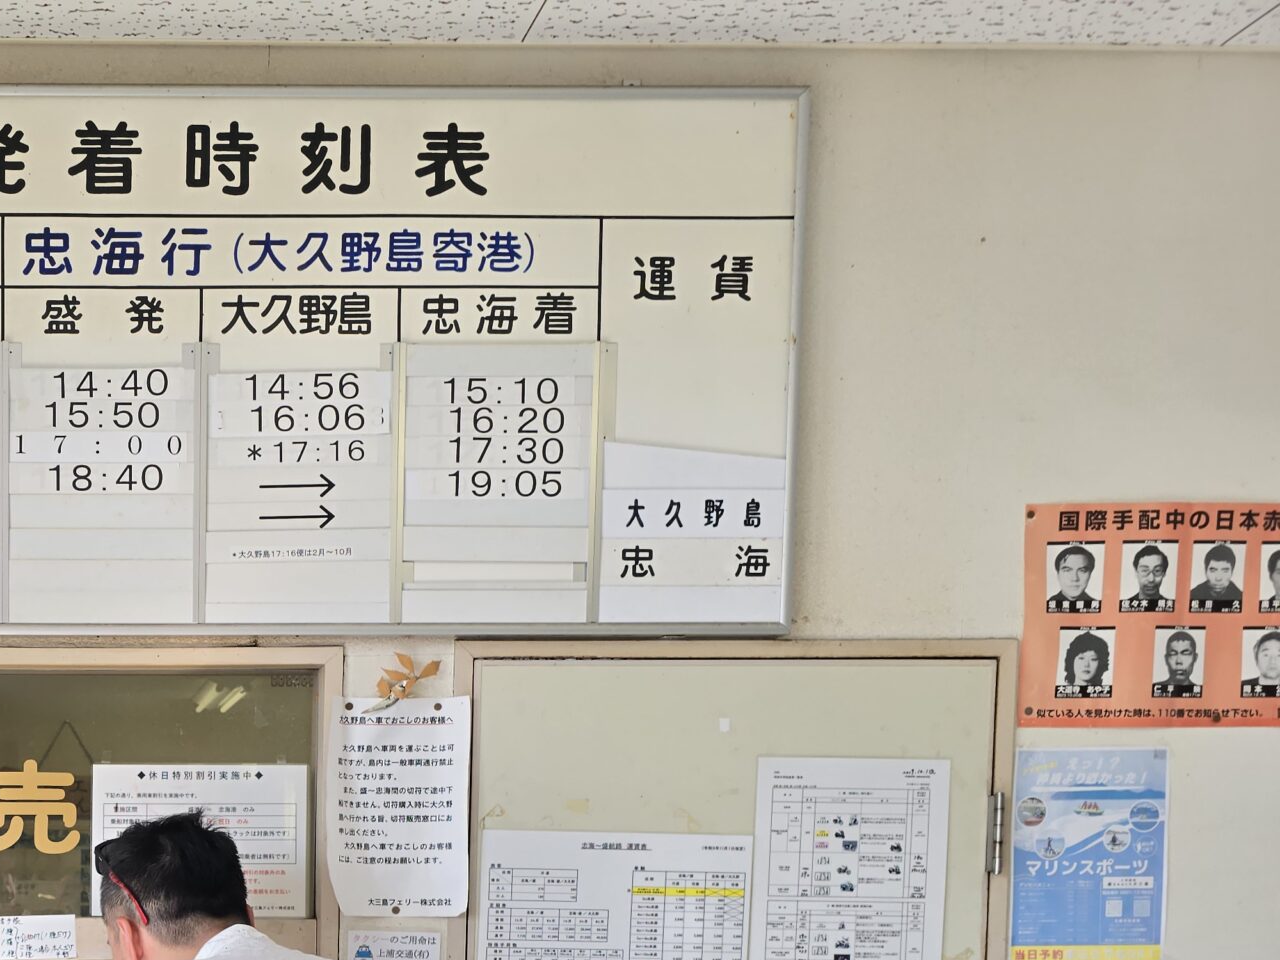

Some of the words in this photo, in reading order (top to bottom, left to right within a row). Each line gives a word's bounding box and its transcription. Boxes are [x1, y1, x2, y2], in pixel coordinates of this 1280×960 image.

[634, 255, 753, 301] 運賃
[42, 295, 164, 334] 盛発
[222, 292, 371, 334] 大久野島
[423, 292, 576, 334] 忠海着
[54, 369, 168, 398] 14:40
[246, 373, 358, 400] 14:56
[444, 378, 558, 404] 15:10
[46, 402, 159, 428] 15:50
[251, 404, 364, 431] 16:06
[450, 408, 564, 433] 16:20
[450, 437, 563, 464] 17:30
[49, 465, 162, 491] 18:40
[449, 471, 561, 497] 19:05
[626, 499, 760, 527] 大久野島
[148, 770, 253, 782] 休日特別割引実施中
[1025, 858, 1149, 877] マリンスポーツ
[368, 898, 453, 907] 大三島フェリー株式会社
[1014, 949, 1064, 960] 当日予約
